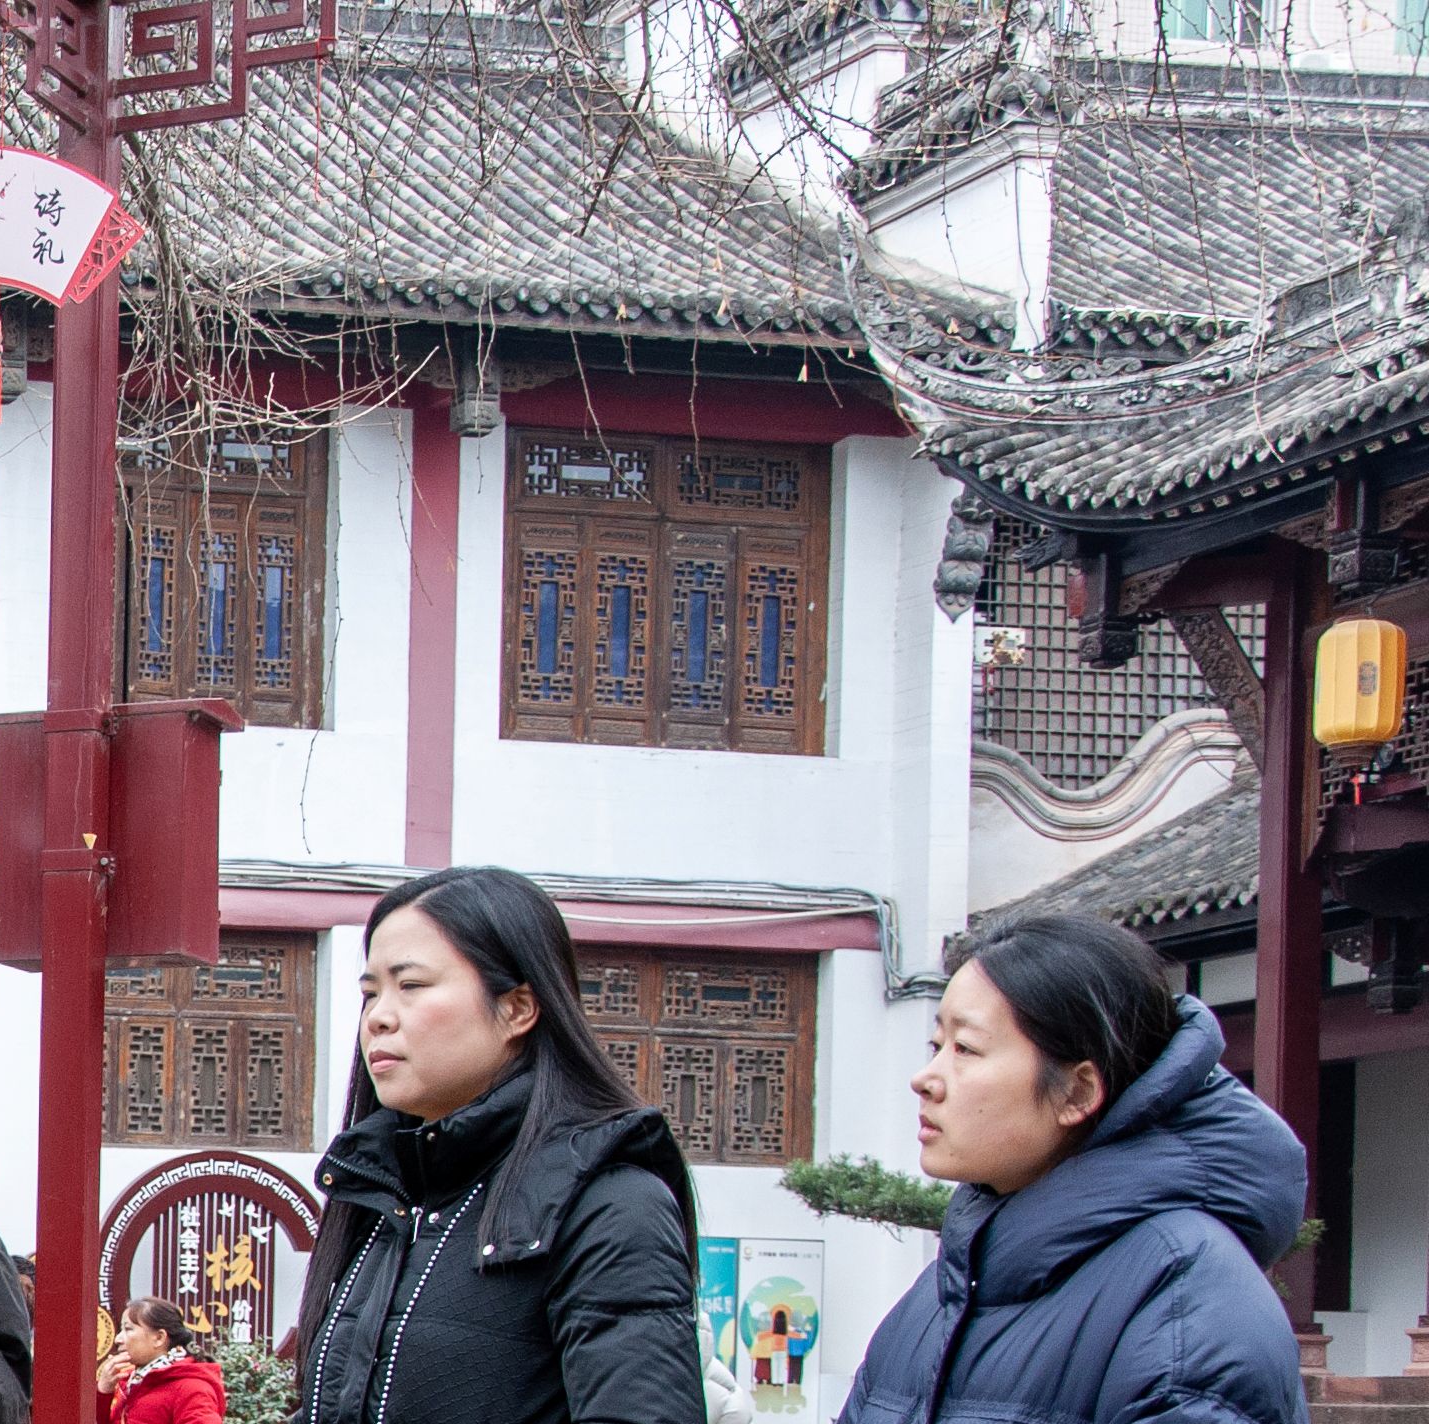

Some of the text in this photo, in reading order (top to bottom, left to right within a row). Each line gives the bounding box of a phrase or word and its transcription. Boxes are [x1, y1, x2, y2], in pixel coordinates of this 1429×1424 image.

[178, 1205, 201, 1295] 社会主义
[204, 1234, 262, 1292] 核
[179, 1301, 229, 1333] 心
[231, 1299, 253, 1343] 价值
